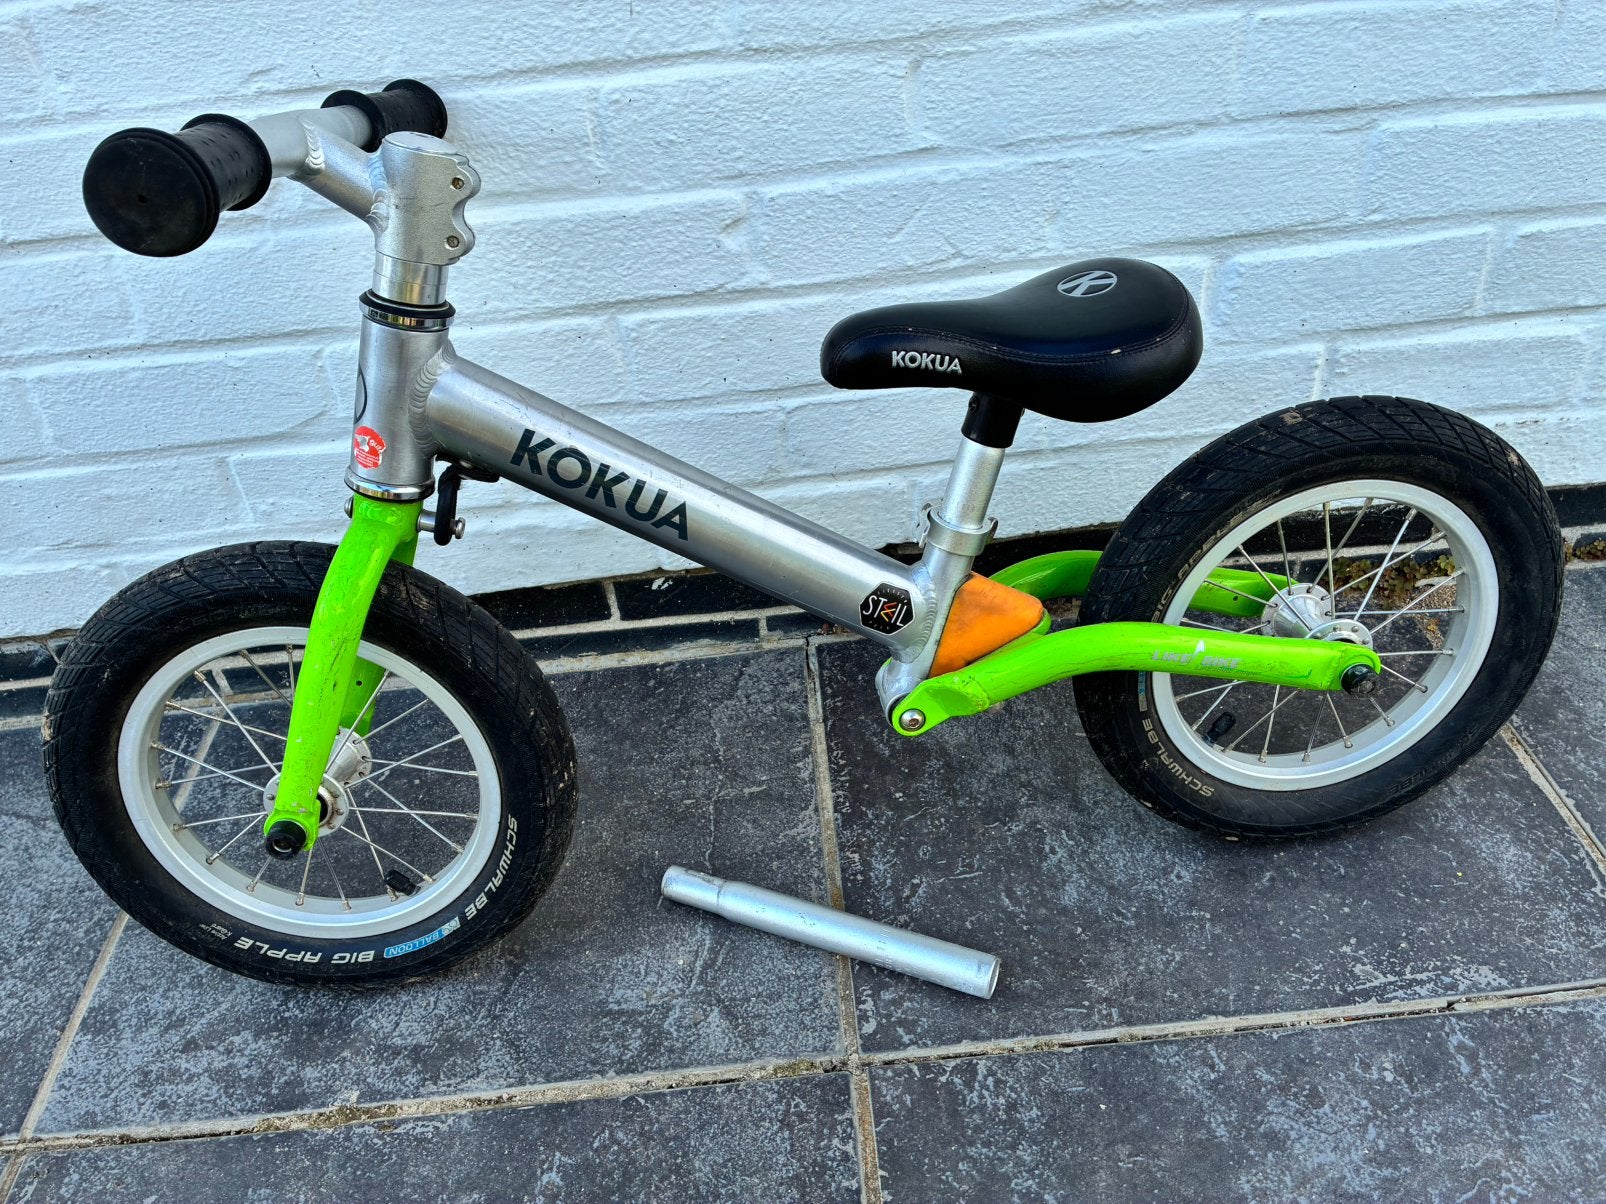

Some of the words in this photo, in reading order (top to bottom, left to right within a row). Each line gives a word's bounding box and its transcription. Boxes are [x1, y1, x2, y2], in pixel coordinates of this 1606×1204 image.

[891, 350, 963, 374] KOKUA
[509, 428, 689, 542] KOKUA
[1142, 718, 1215, 798] SCHWALBE
[465, 813, 518, 920] SCHWALBE
[233, 935, 322, 964] APPLE
[330, 949, 376, 964] BIG
[389, 930, 439, 956] BALLOON
